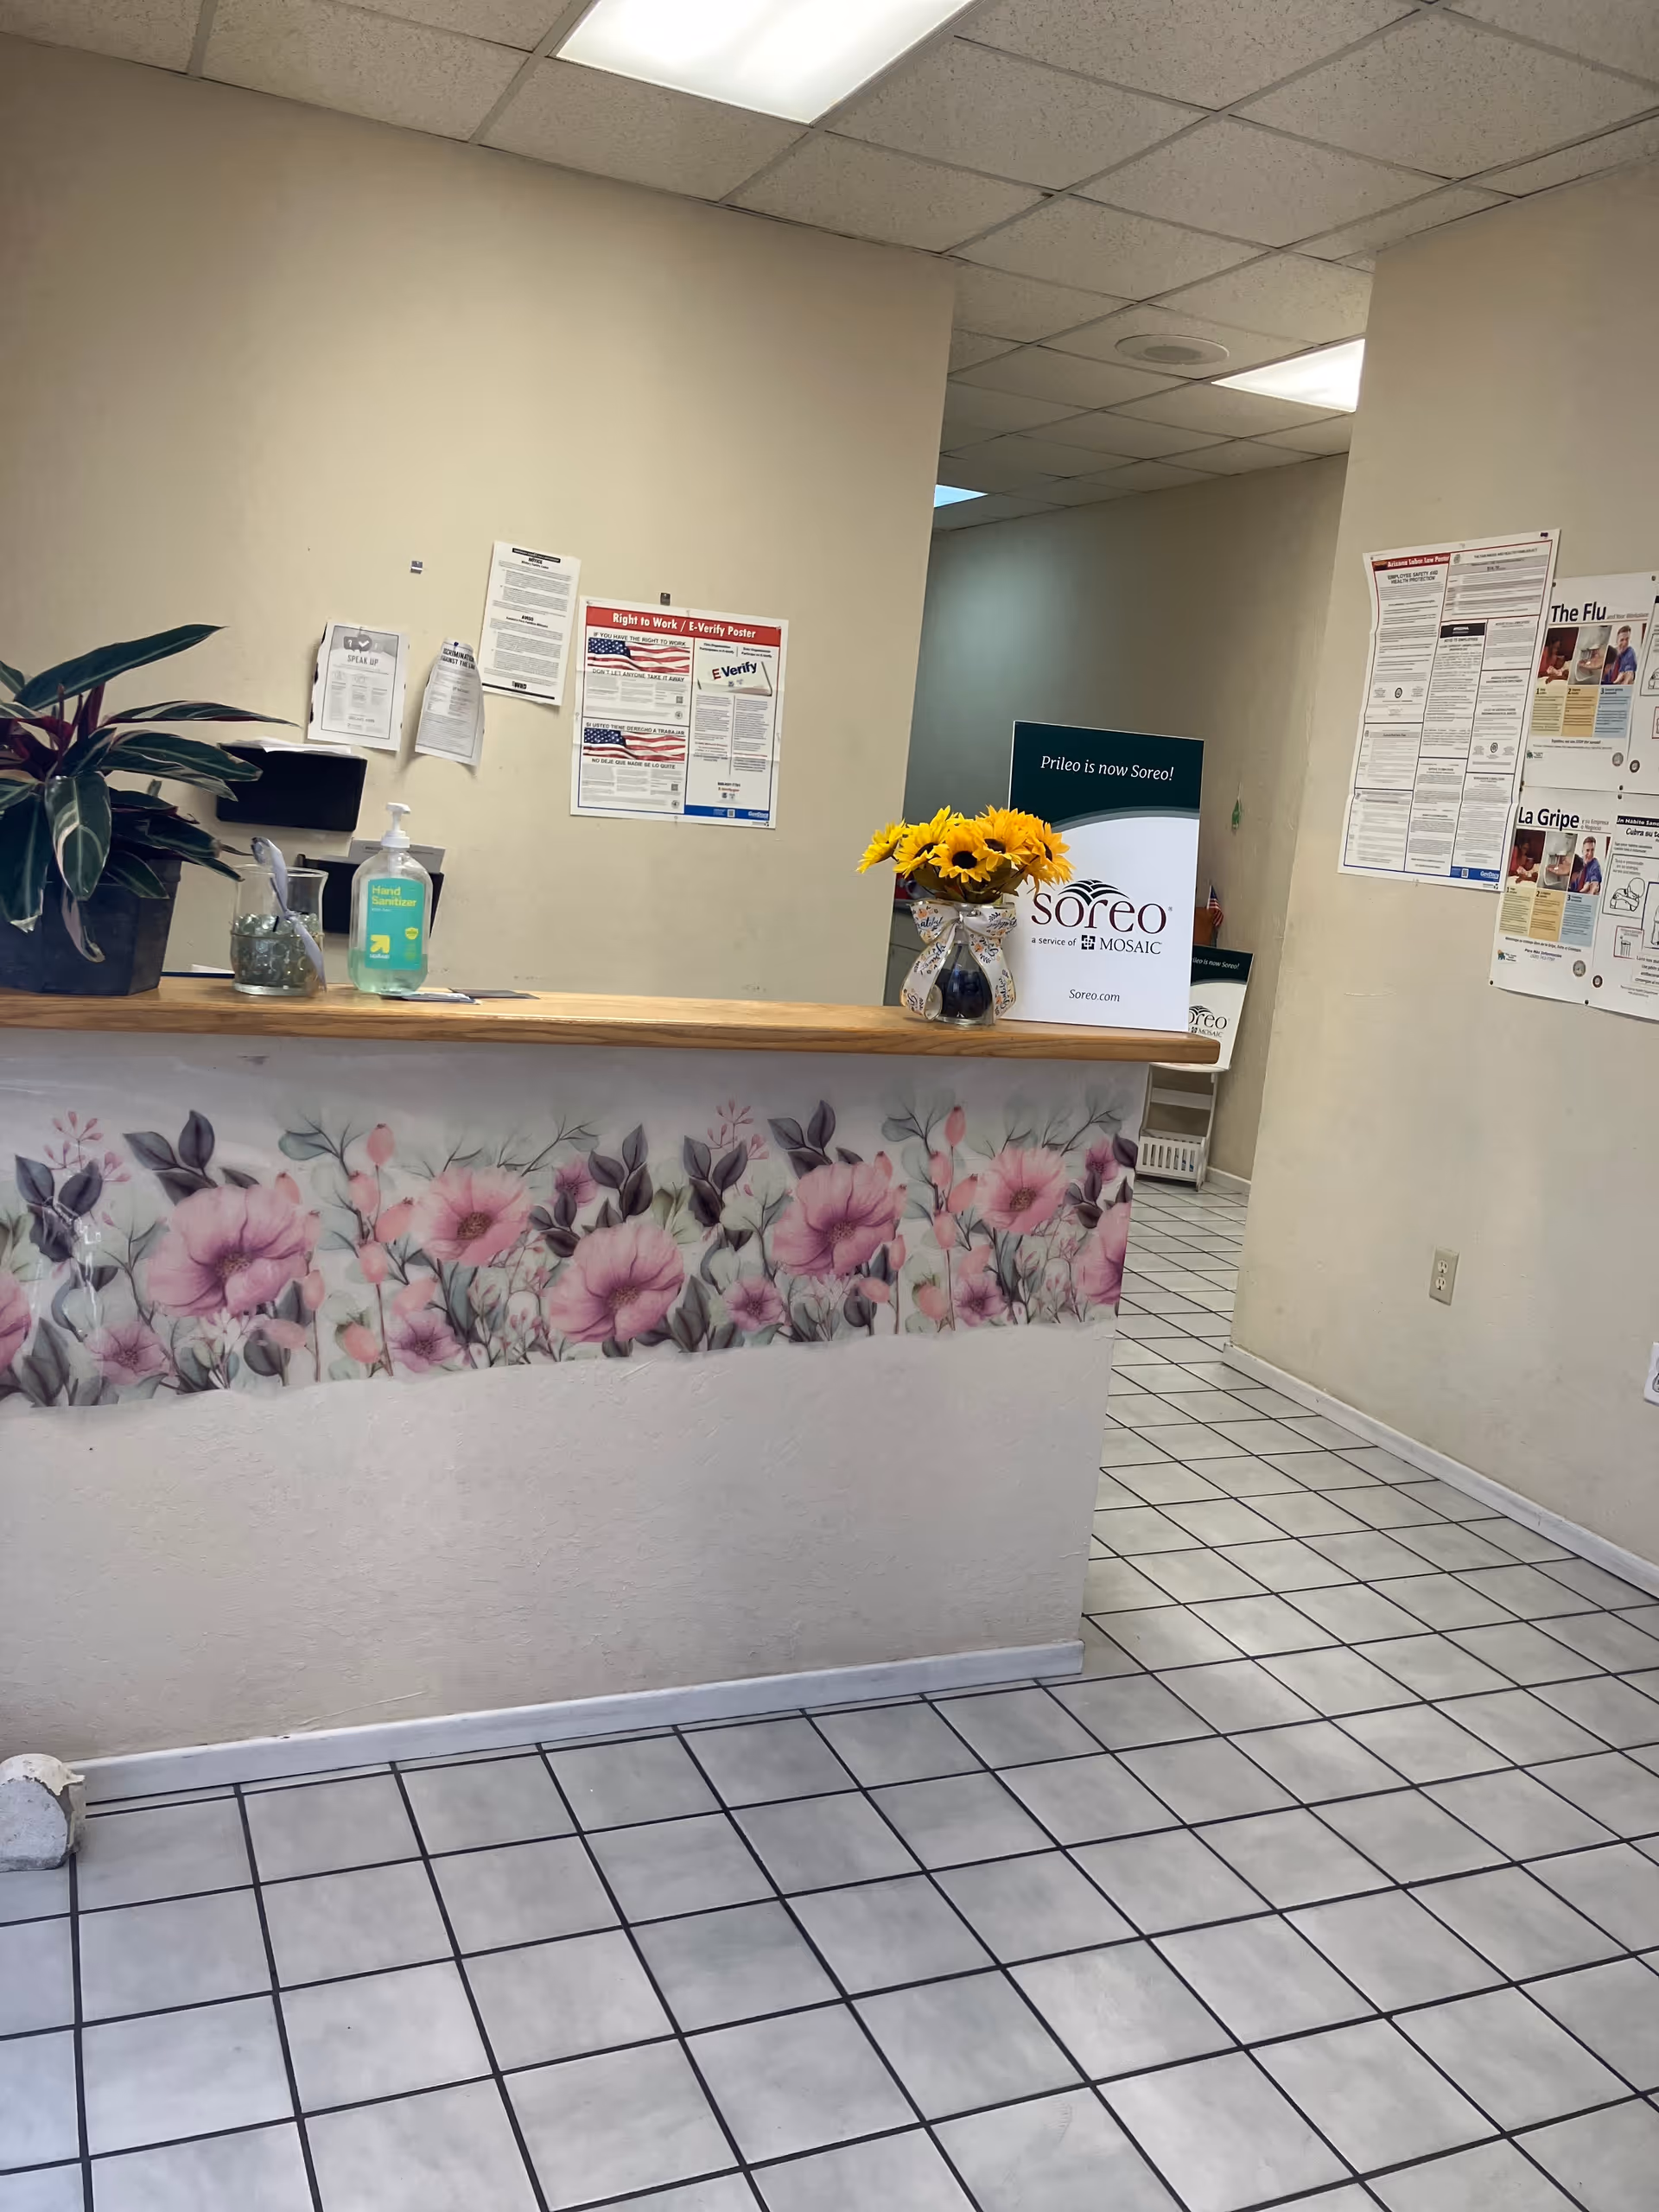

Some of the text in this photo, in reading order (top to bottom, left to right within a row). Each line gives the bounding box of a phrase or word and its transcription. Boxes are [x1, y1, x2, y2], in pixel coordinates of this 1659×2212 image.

[1552, 603, 1579, 622] The
[1583, 601, 1606, 621] Flu
[613, 613, 638, 626] Right
[640, 616, 650, 626] to
[653, 618, 677, 631] Work
[689, 621, 725, 637] E-Verify
[728, 626, 756, 639] Poster
[347, 655, 368, 664] SPEAK
[721, 662, 757, 677] Verify
[1040, 755, 1173, 781] Prileo is now Soreo!
[1518, 807, 1533, 824] La
[1538, 808, 1580, 831] Gripe
[372, 885, 401, 895] Hand
[372, 895, 416, 906] Sanitizer
[1039, 938, 1065, 946] service
[1100, 938, 1162, 955] MOSAIC
[1069, 988, 1120, 1002] Soreo.com
[1189, 1011, 1227, 1029] oreo
[1198, 1028, 1224, 1037] MOSAIC
